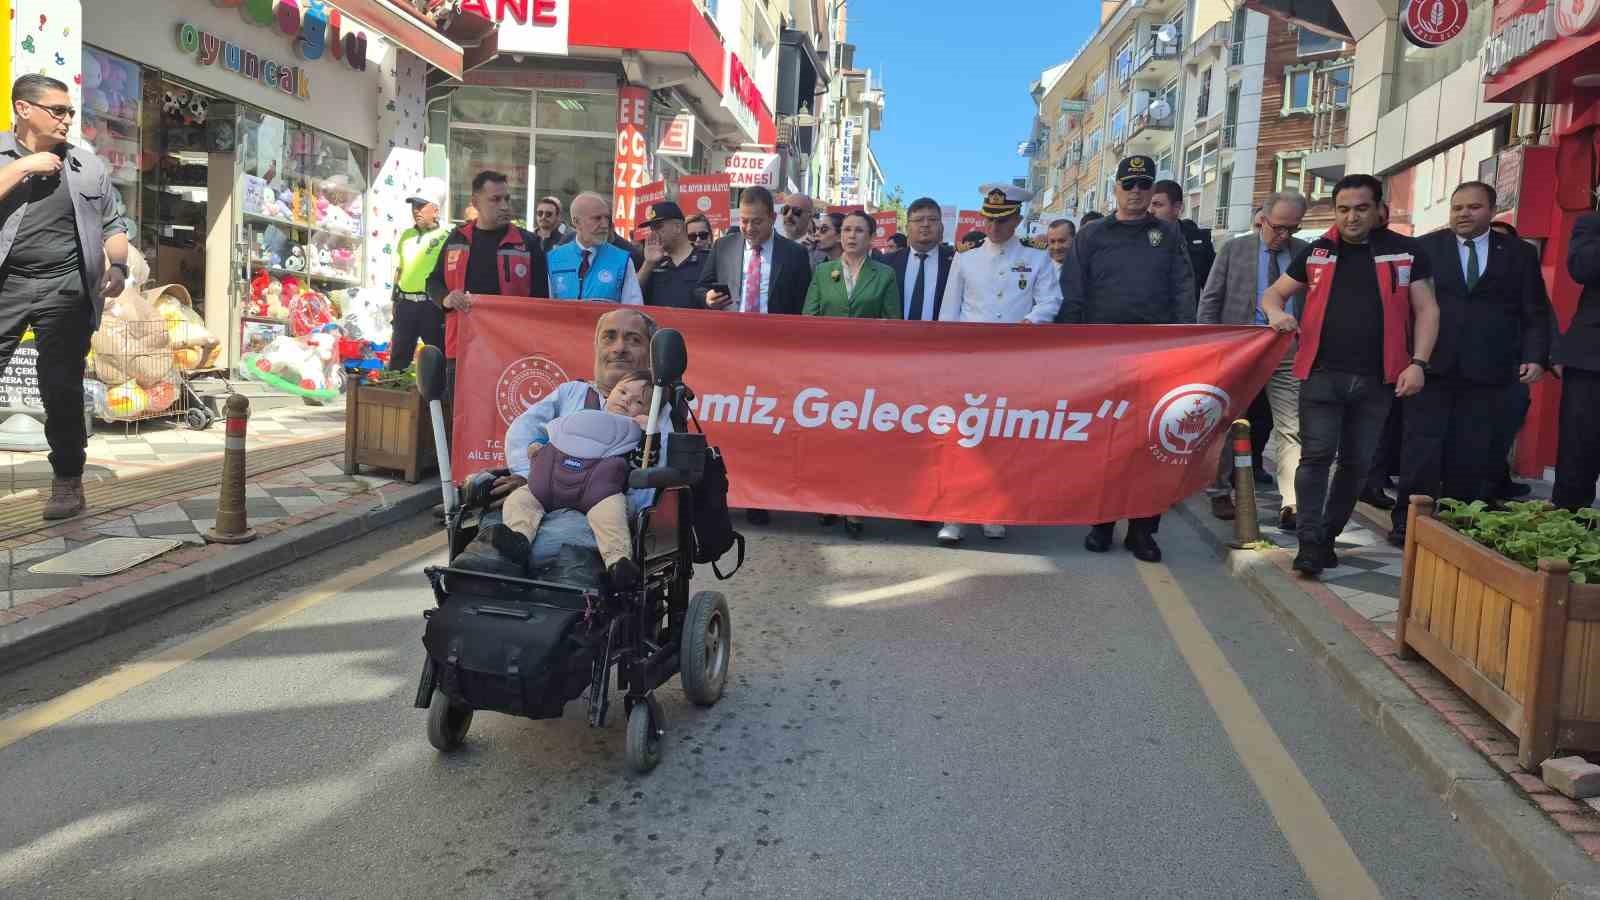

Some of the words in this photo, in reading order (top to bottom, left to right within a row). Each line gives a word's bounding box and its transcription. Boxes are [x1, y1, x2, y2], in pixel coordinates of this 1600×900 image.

[178, 22, 311, 100] oyuncak
[725, 155, 765, 169] GÖZDE
[0, 376, 22, 384] MERA
[468, 450, 490, 460] AİLE
[492, 452, 505, 461] VE
